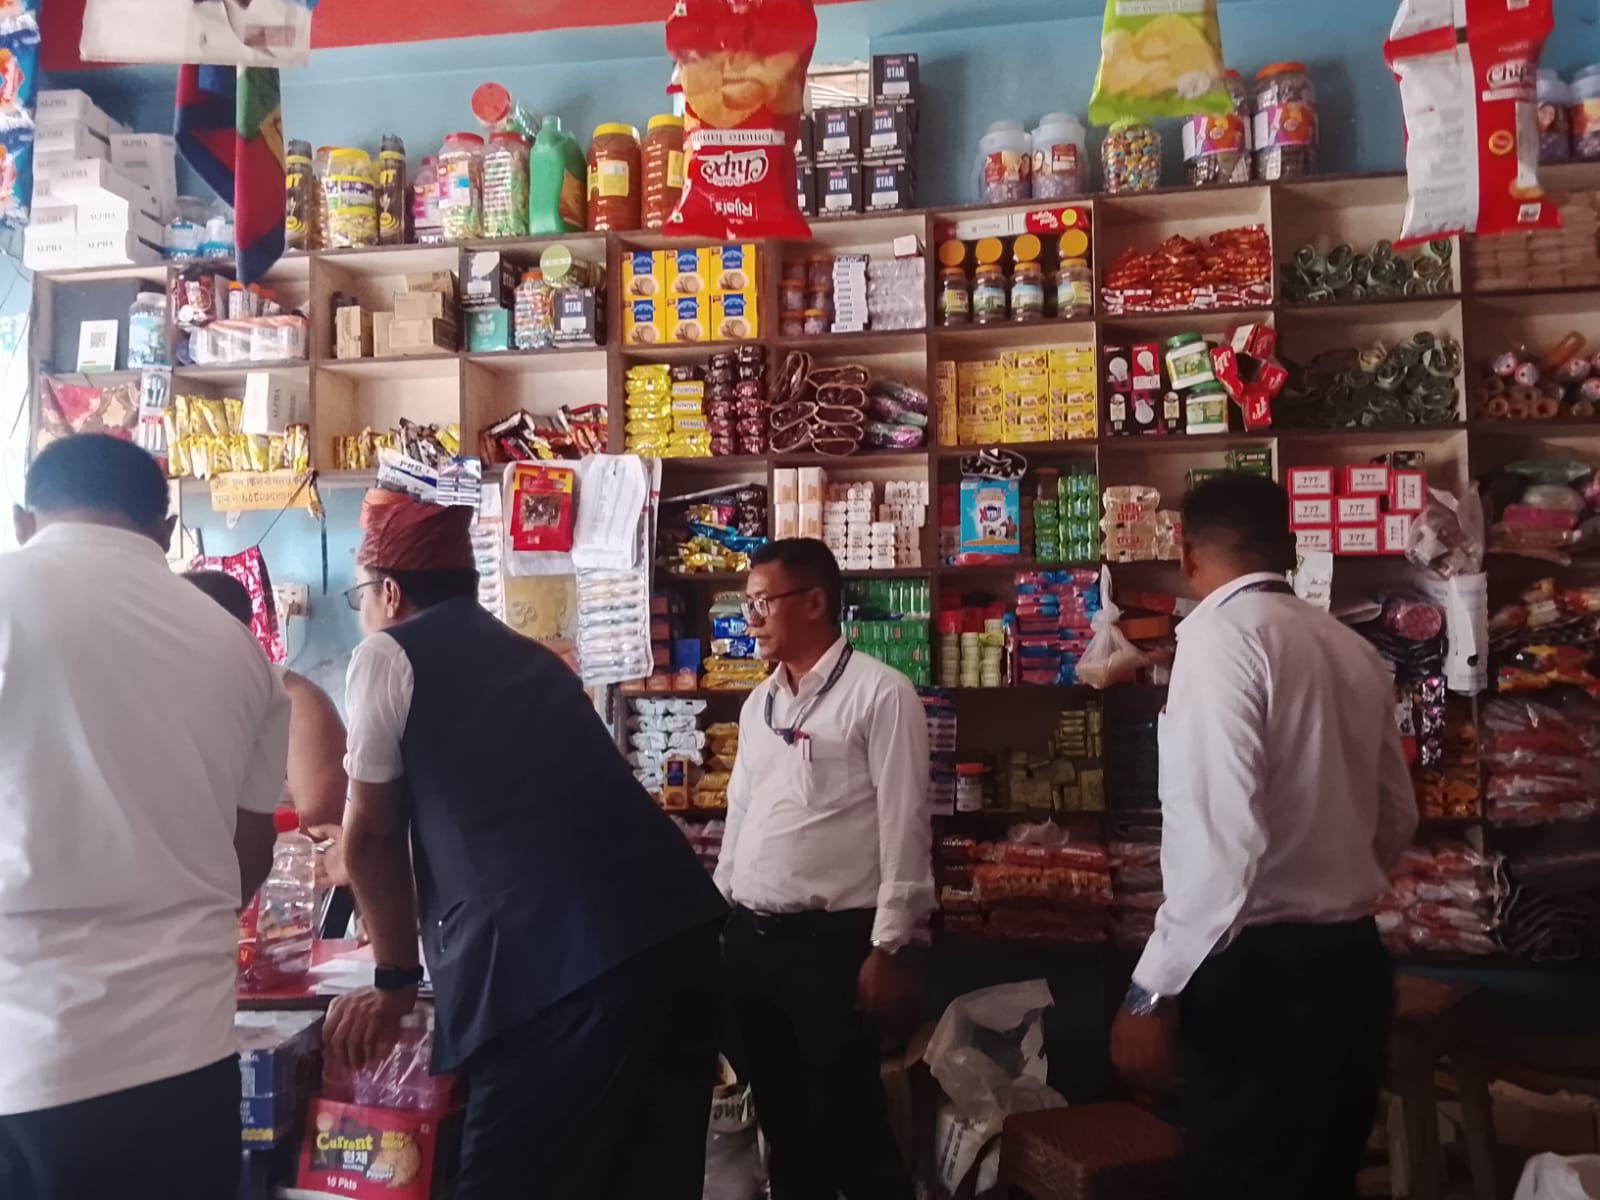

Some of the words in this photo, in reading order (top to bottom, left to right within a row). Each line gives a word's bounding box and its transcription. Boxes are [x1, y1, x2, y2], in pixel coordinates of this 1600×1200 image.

[886, 66, 905, 79] STAR
[40, 99, 67, 107] ALPHA
[827, 121, 845, 134] STAR
[874, 117, 893, 131] STAR
[121, 139, 148, 148] ALPHA
[61, 169, 88, 178] ALPHA
[829, 178, 848, 191] STAR
[875, 175, 894, 188] STAR
[37, 215, 63, 224] ALPHA
[90, 212, 116, 221] ALPHA
[37, 244, 62, 253] ALPHA
[88, 240, 114, 249] ALPHA
[564, 301, 582, 313] STAR
[1303, 476, 1319, 484] 777
[1360, 473, 1376, 481] 777
[1349, 504, 1365, 512] 777
[316, 1131, 374, 1151] Current
[326, 1175, 336, 1188] 10
